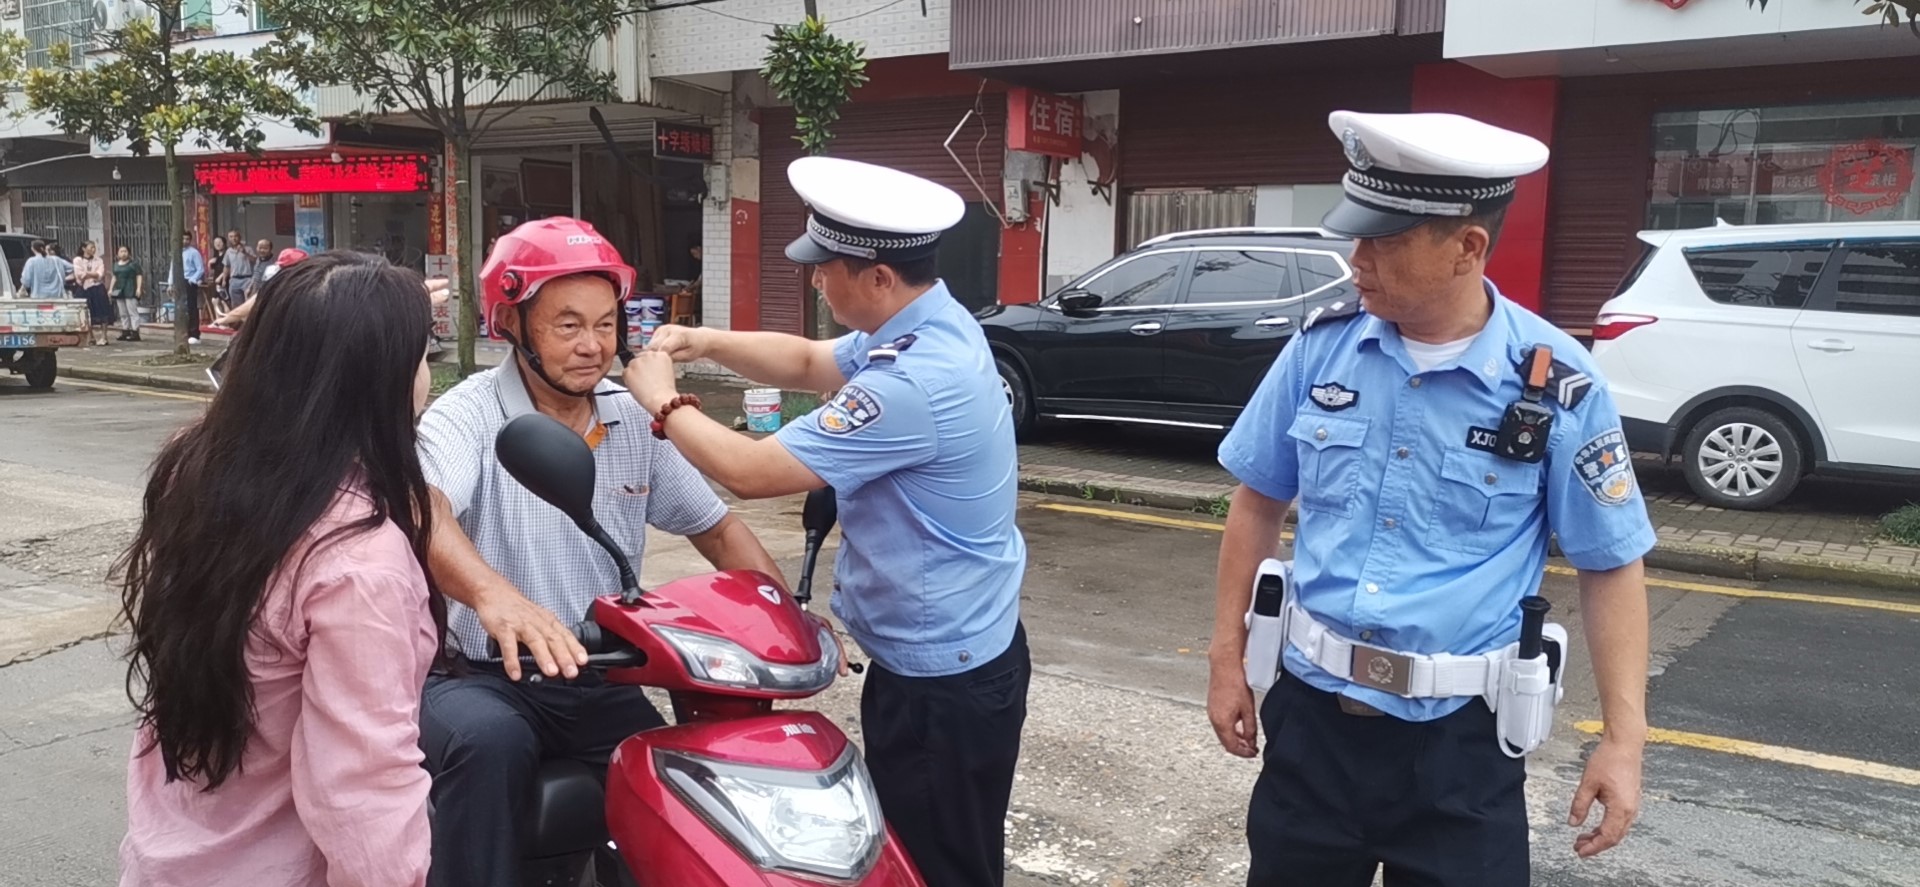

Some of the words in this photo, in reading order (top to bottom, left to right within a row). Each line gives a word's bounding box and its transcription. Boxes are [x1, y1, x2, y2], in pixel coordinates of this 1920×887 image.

[1030, 95, 1074, 137] 住宿
[1773, 174, 1817, 188] 阴凉柜
[431, 257, 450, 334] 十表框
